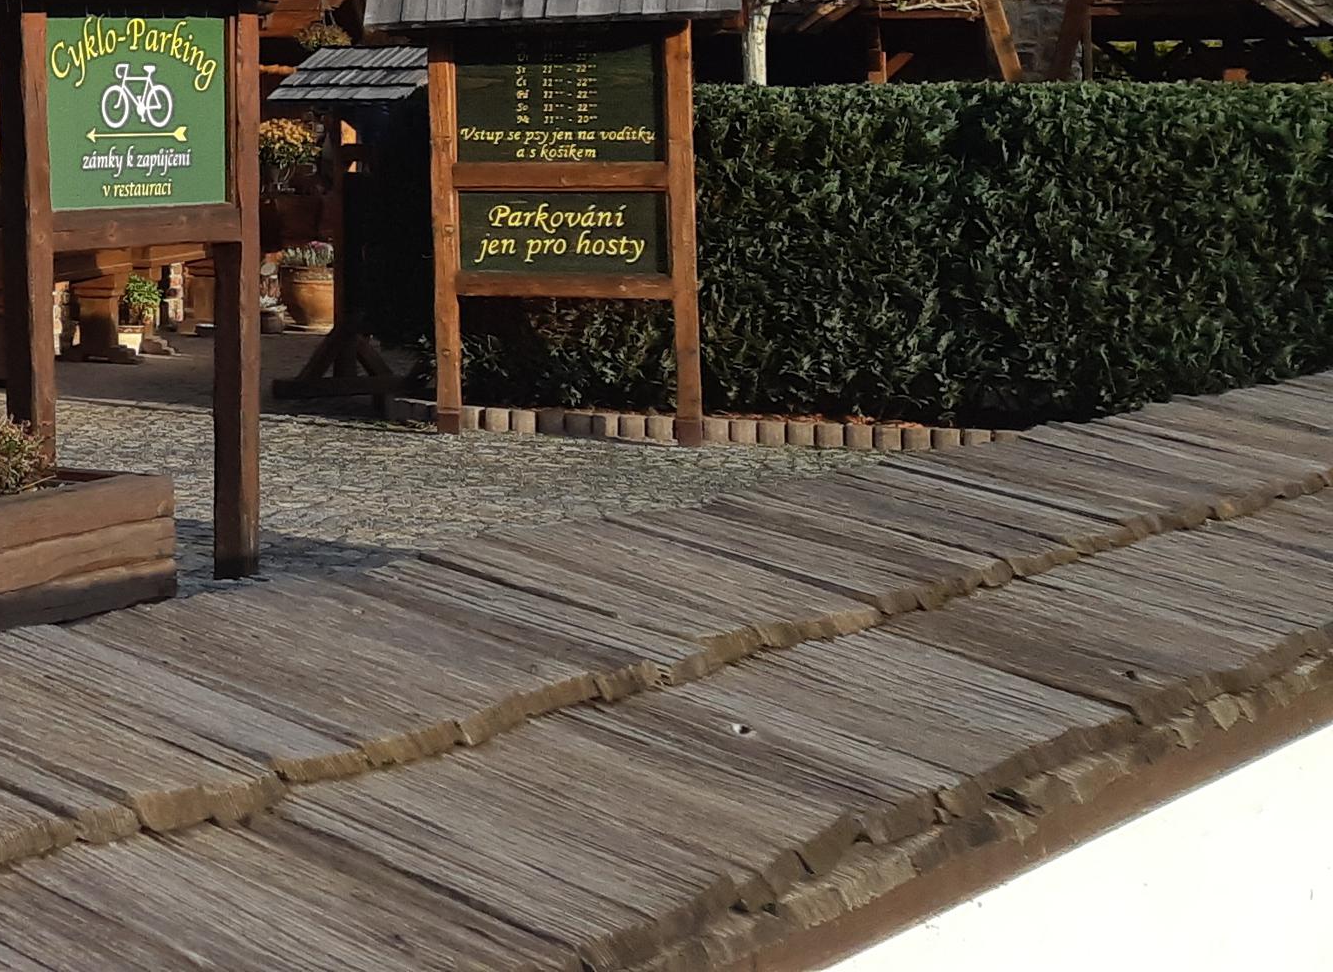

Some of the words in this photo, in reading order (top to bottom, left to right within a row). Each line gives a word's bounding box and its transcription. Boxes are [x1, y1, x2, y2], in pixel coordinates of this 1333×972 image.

[51, 15, 216, 91] Cyklo-Parking
[460, 128, 504, 144] Vstup
[507, 131, 520, 141] se
[524, 131, 549, 145] psy
[552, 128, 573, 145] jen
[578, 131, 595, 141] na
[82, 146, 122, 177] zámky
[127, 146, 134, 168] k
[137, 147, 190, 175] zapůjčení
[516, 148, 524, 158] a
[530, 148, 536, 158] s
[102, 184, 111, 196] v
[114, 179, 172, 196] restauraci
[489, 203, 626, 233] Parkování
[474, 233, 516, 262] jen
[524, 238, 567, 261] pro
[575, 231, 645, 263] hosty
